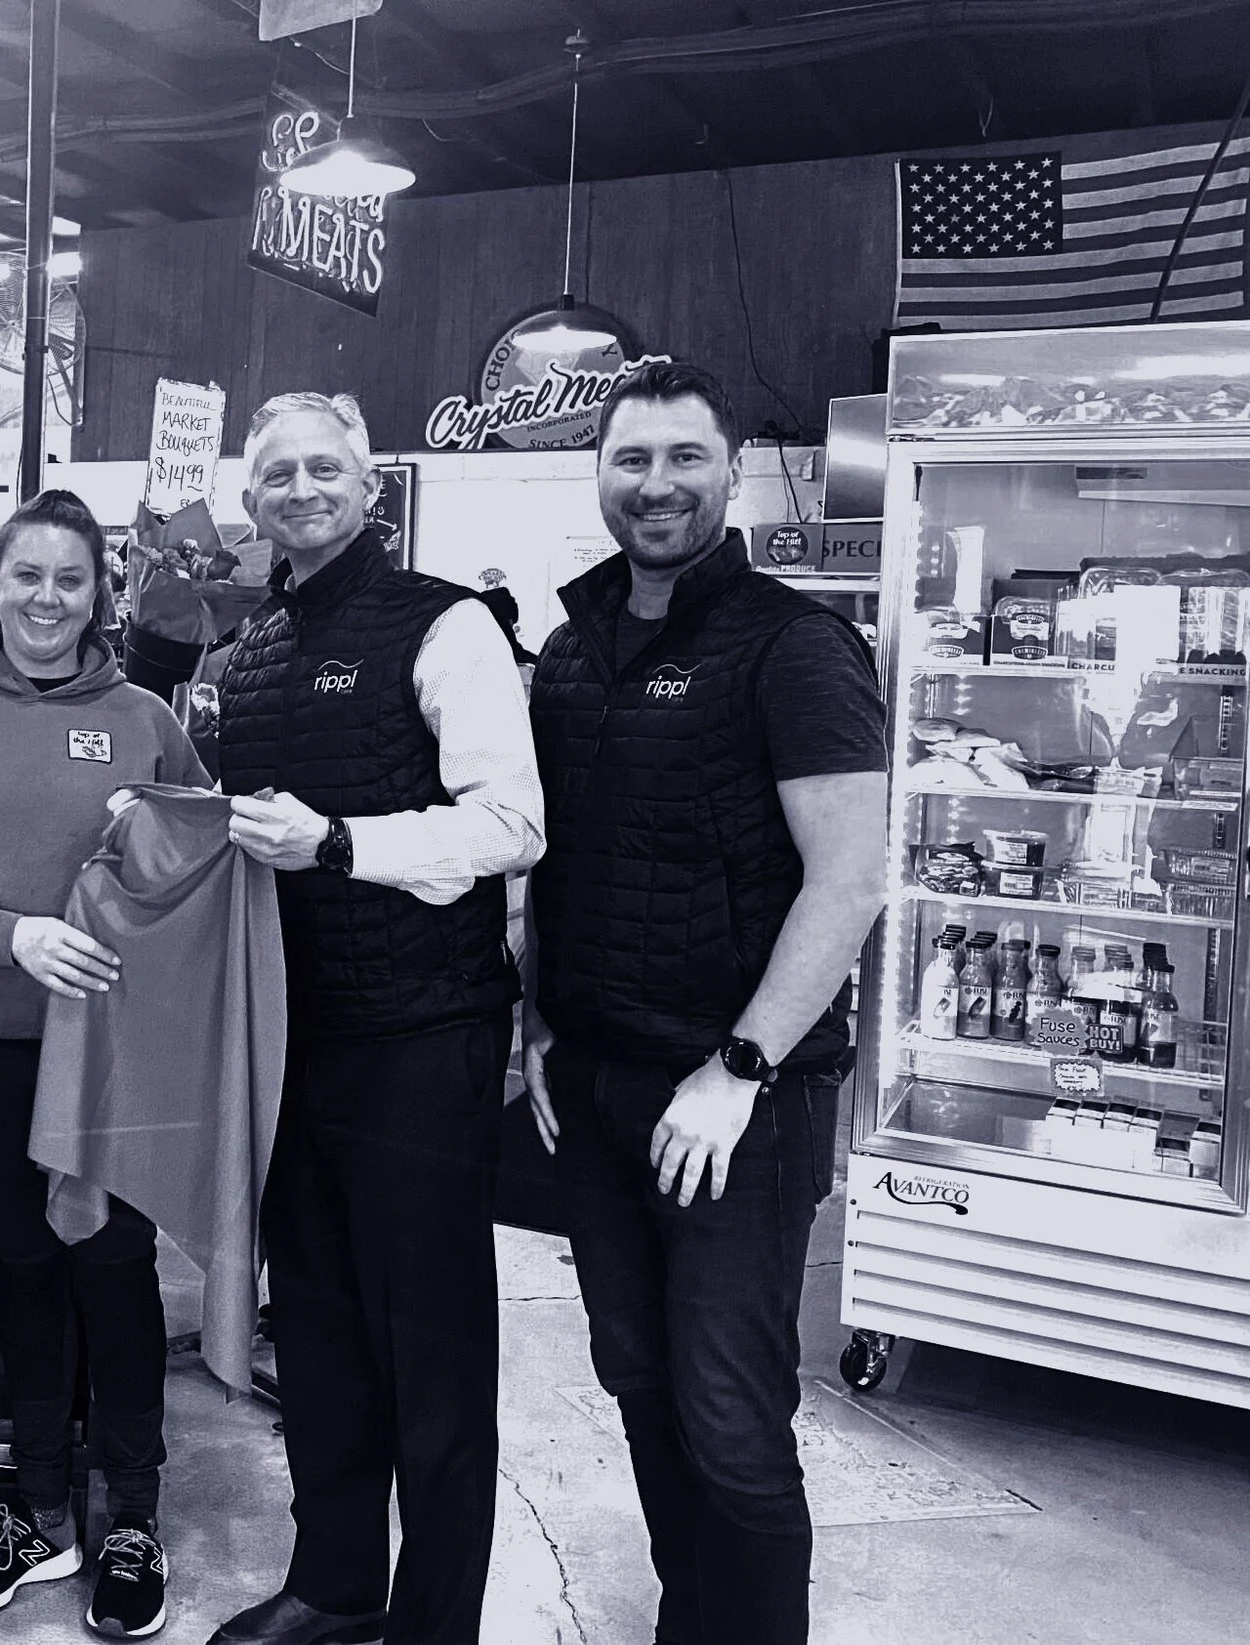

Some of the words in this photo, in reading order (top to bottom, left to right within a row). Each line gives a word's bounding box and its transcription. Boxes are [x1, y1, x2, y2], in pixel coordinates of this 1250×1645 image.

[277, 185, 385, 294] MEATS
[161, 411, 211, 431] MARKET
[427, 377, 552, 450] Crystal
[527, 411, 592, 432] INCORPORATED
[155, 430, 214, 457] BOUQUETS
[529, 438, 567, 449] SINCE
[571, 424, 595, 444] 1947
[781, 564, 816, 573] PRODUCE
[313, 669, 358, 693] rippl
[1189, 667, 1246, 676] SNACKING
[645, 675, 692, 699] rippl
[1040, 1017, 1076, 1034] Fuse
[1089, 1026, 1119, 1039] HOT
[1037, 1032, 1080, 1047] Sauces
[1089, 1038, 1120, 1050] BUY!
[872, 1171, 970, 1214] AVANTCO
